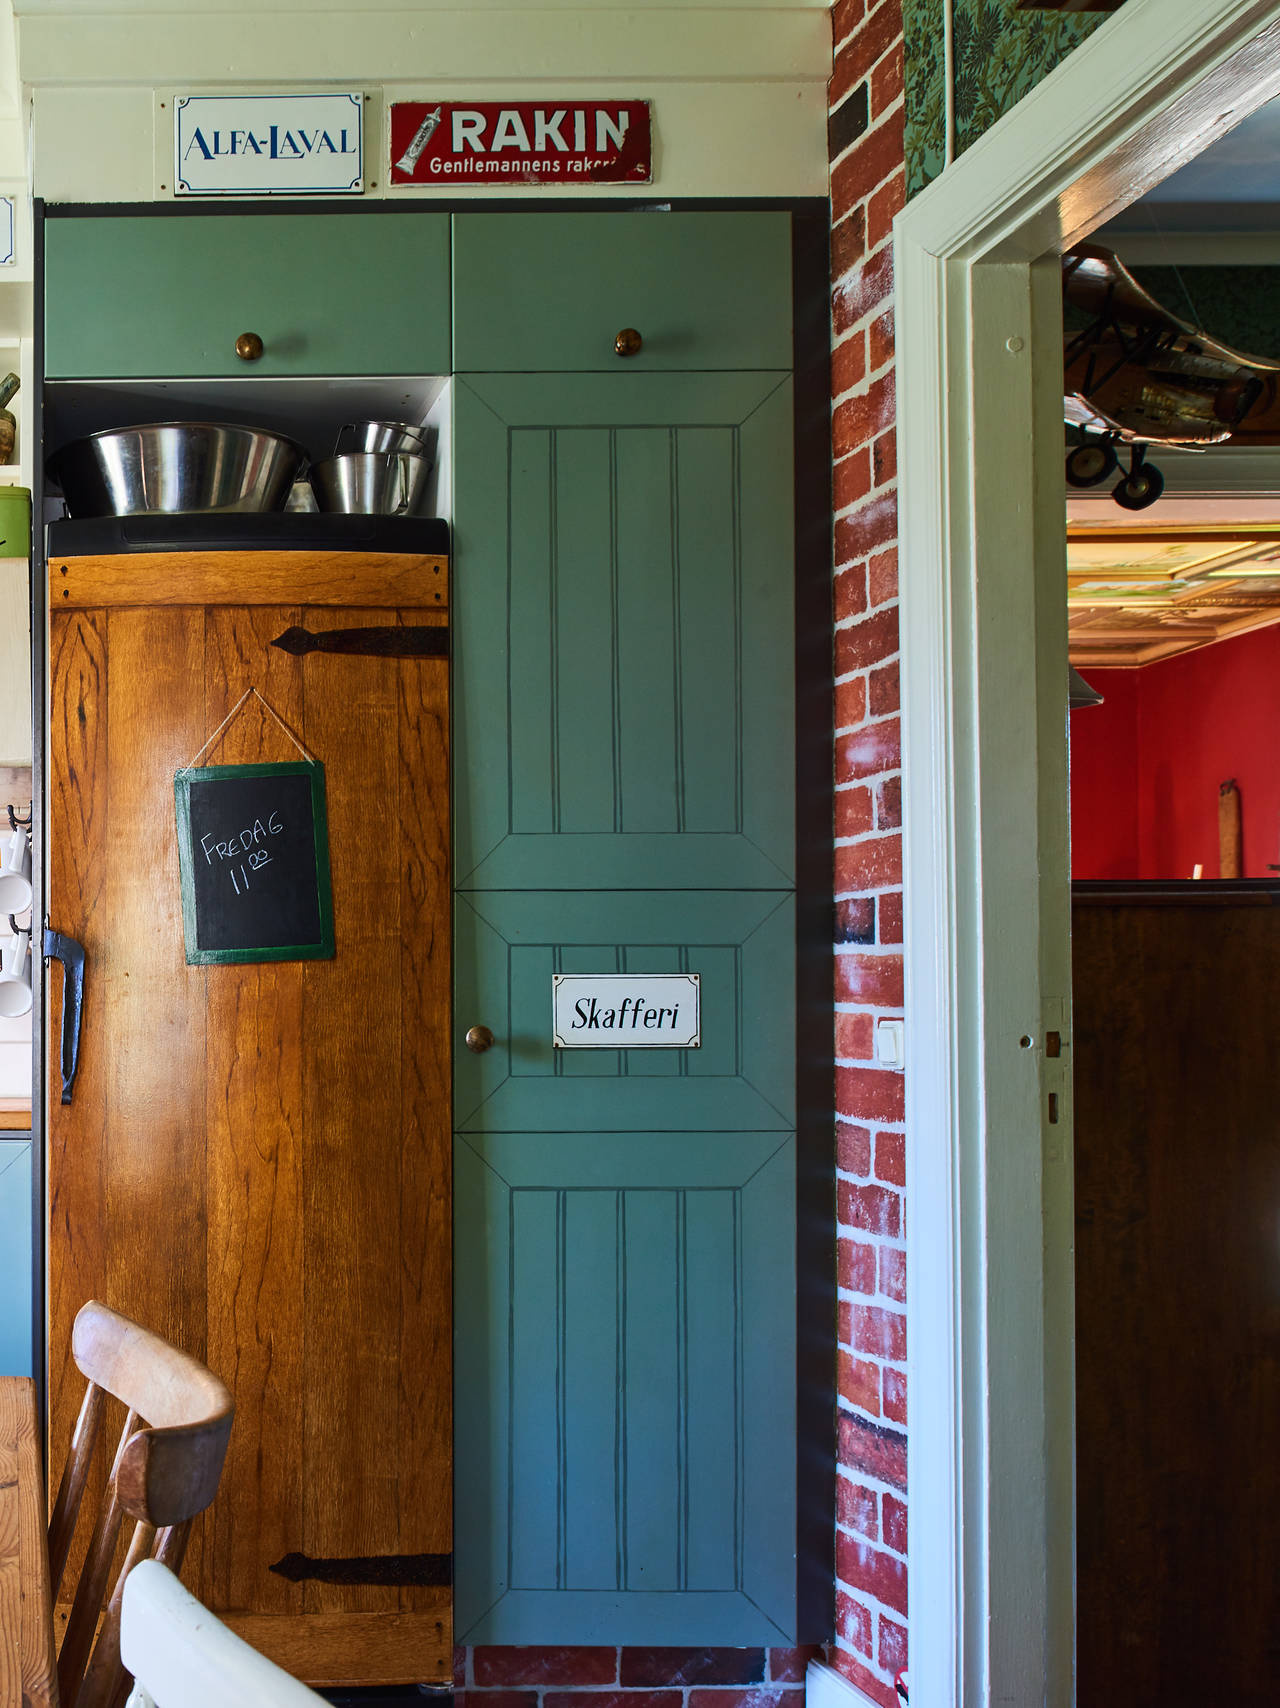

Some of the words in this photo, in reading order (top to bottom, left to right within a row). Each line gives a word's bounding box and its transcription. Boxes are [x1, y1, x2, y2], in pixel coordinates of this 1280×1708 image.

[452, 109, 630, 153] RAKIN
[430, 157, 560, 173] Gentlemannens
[200, 811, 284, 865] FREDAG
[571, 998, 680, 1029] Skafferi
